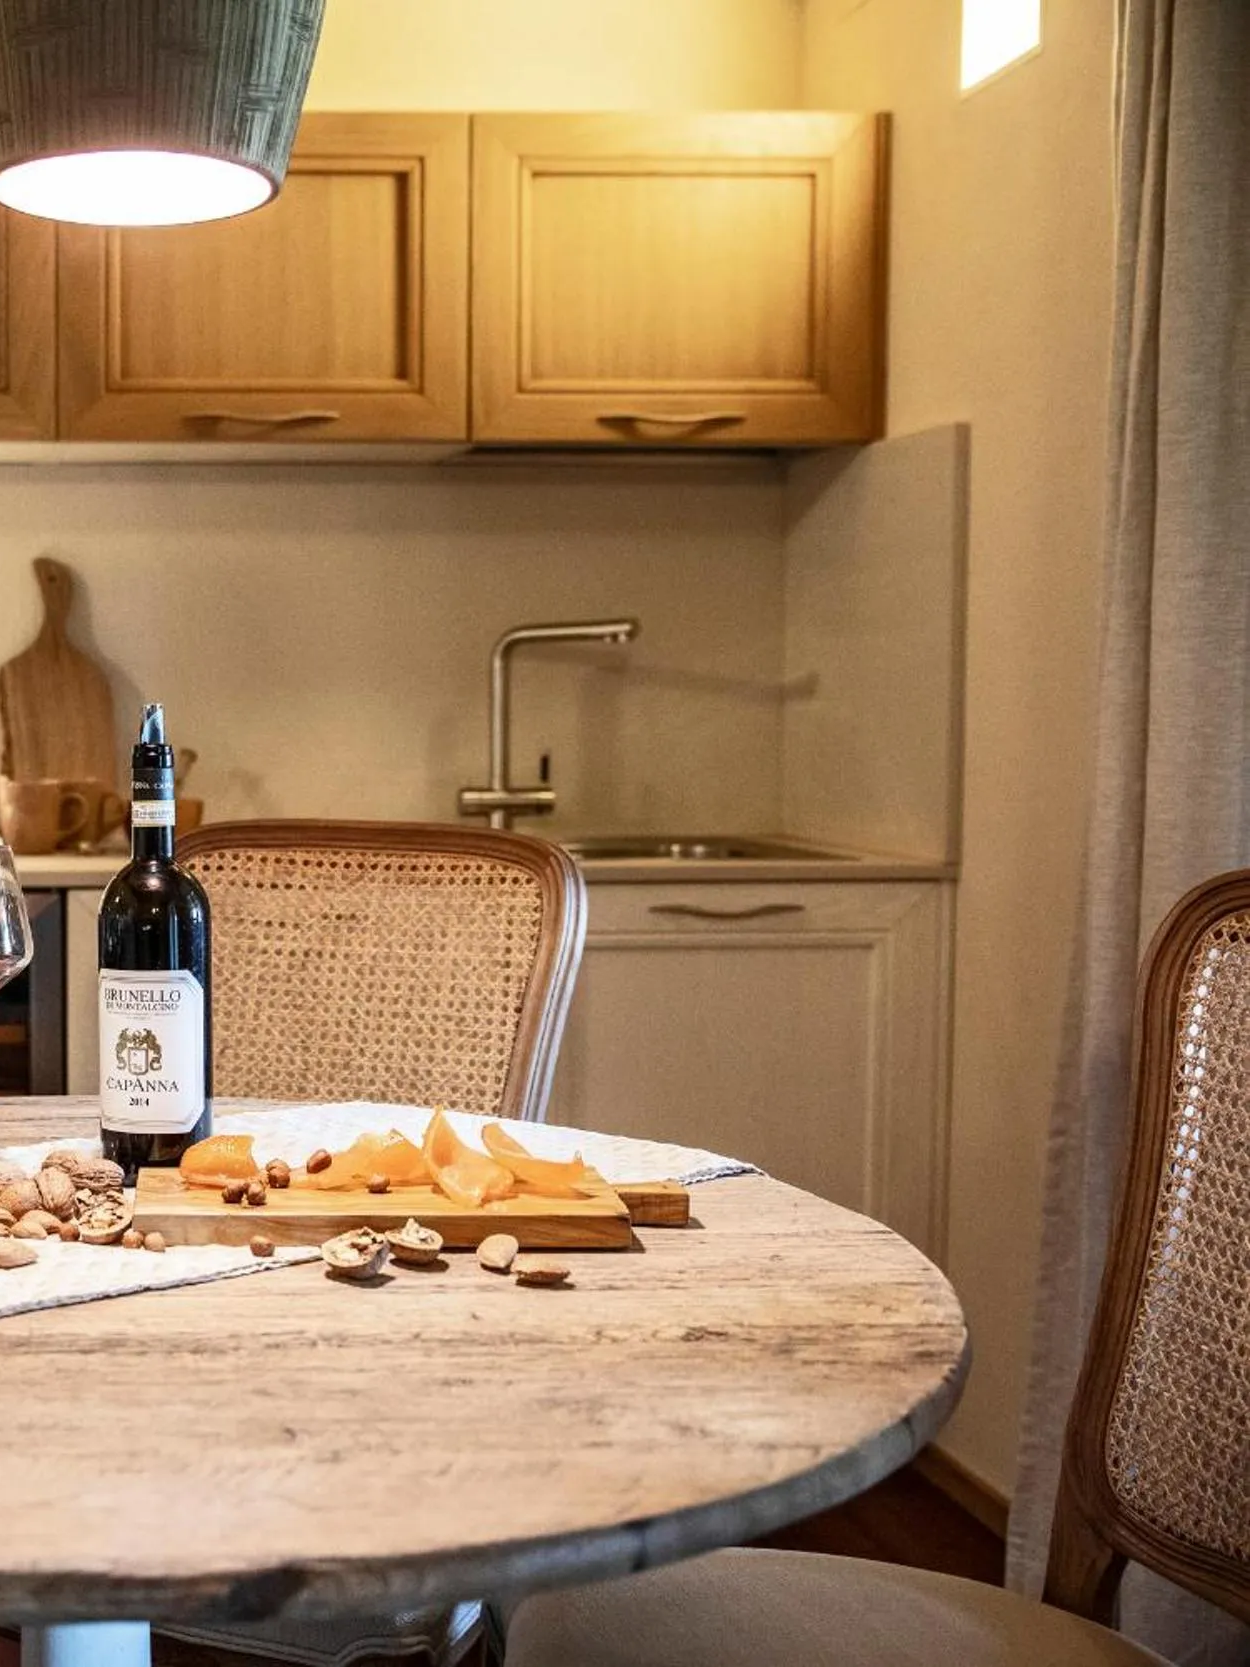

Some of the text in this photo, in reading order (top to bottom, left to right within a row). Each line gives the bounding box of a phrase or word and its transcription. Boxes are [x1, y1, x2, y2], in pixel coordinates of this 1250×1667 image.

[104, 988, 181, 1002] BRUNELLO
[106, 1076, 179, 1092] CAPANNA
[129, 1097, 150, 1107] 2014
